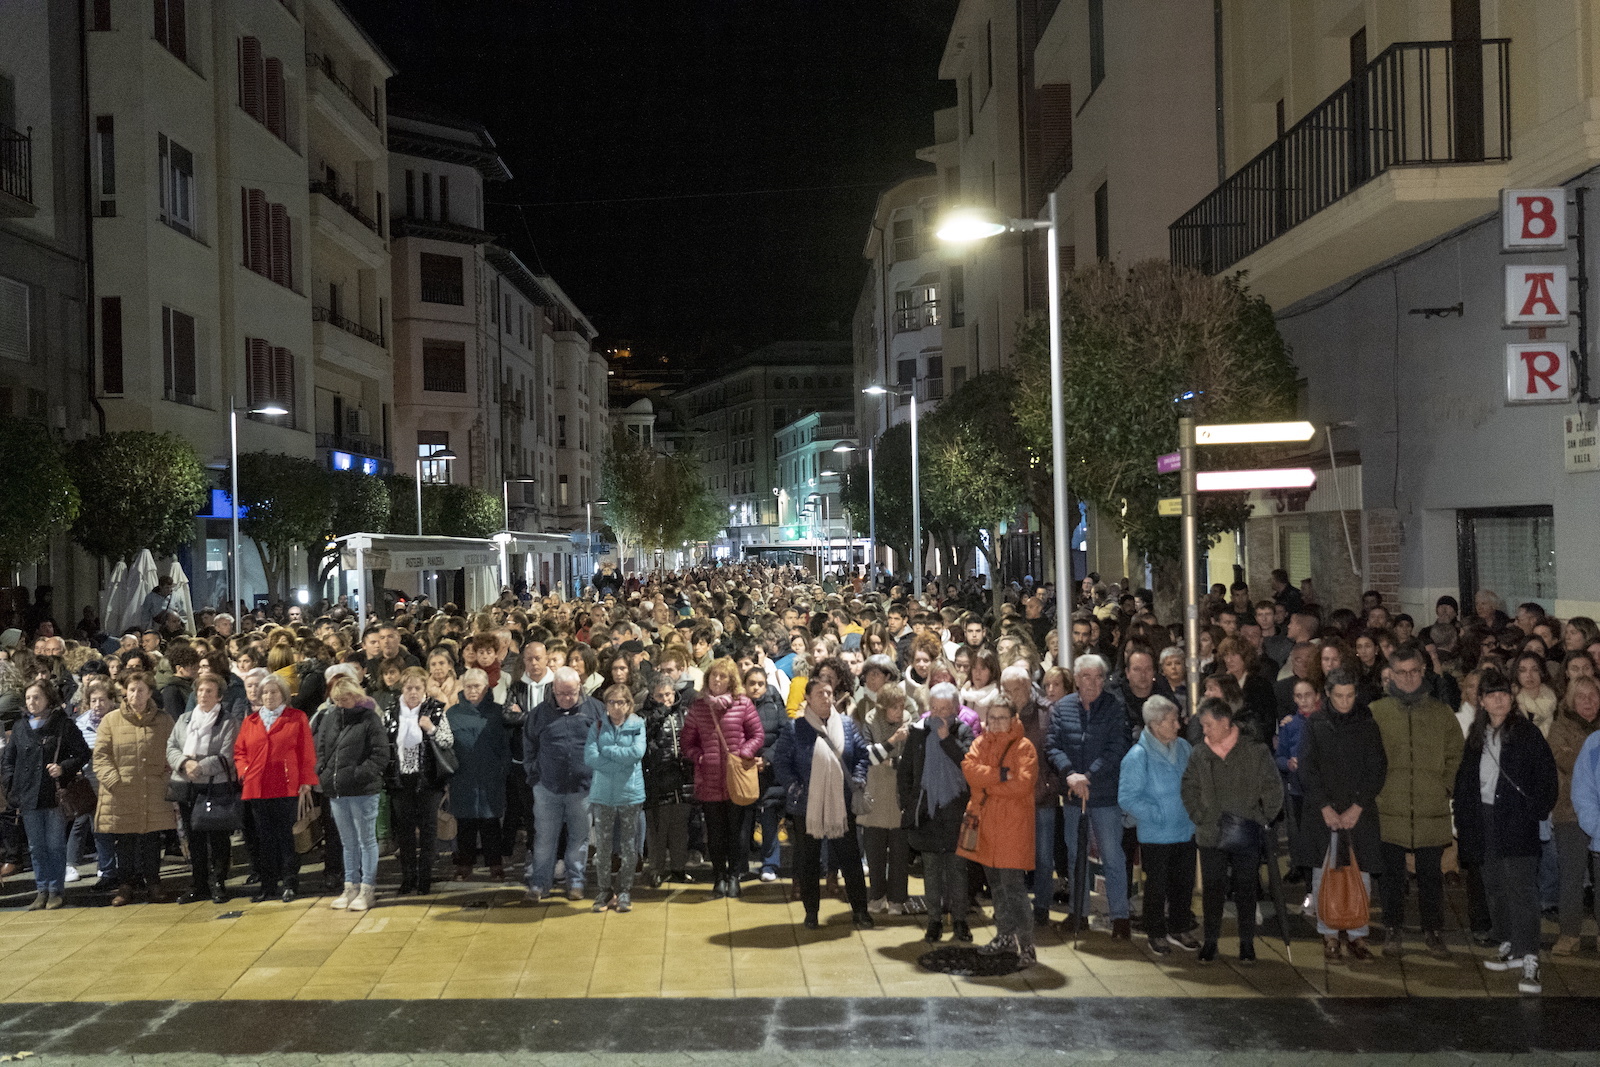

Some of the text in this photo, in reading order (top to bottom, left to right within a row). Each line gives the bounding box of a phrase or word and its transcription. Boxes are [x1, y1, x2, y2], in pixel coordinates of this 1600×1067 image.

[1517, 197, 1561, 394] BAR
[1568, 440, 1576, 448] SAN
[1574, 454, 1591, 463] KALEA
